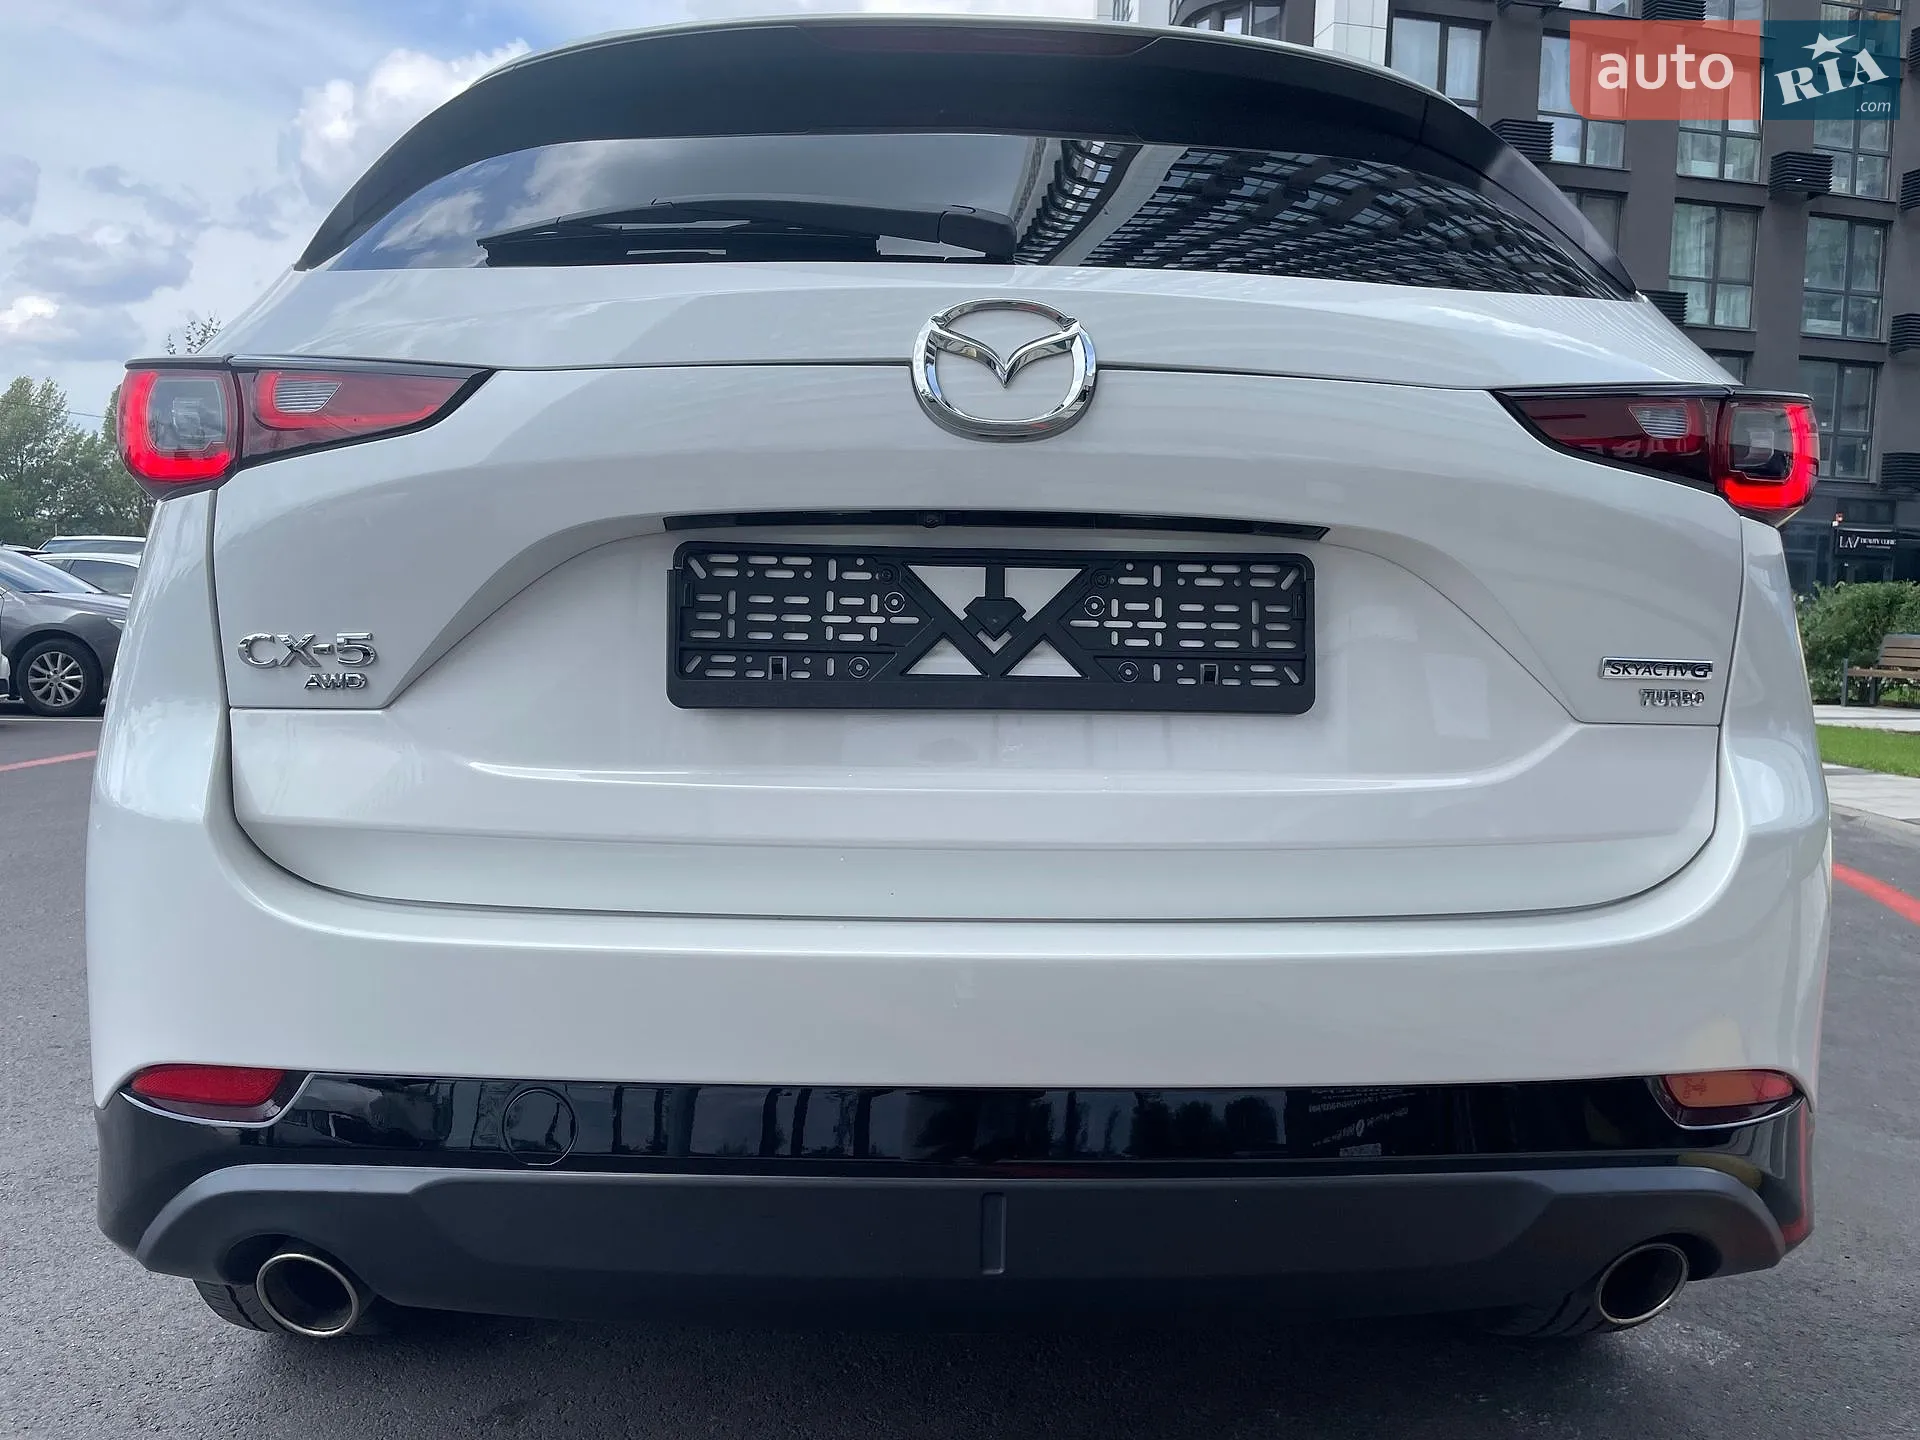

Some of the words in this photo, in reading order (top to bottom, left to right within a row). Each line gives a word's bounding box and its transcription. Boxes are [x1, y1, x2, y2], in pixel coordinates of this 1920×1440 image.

[237, 632, 378, 669] CX-5
[303, 672, 368, 690] AWD
[1639, 688, 1705, 707] TURBO
